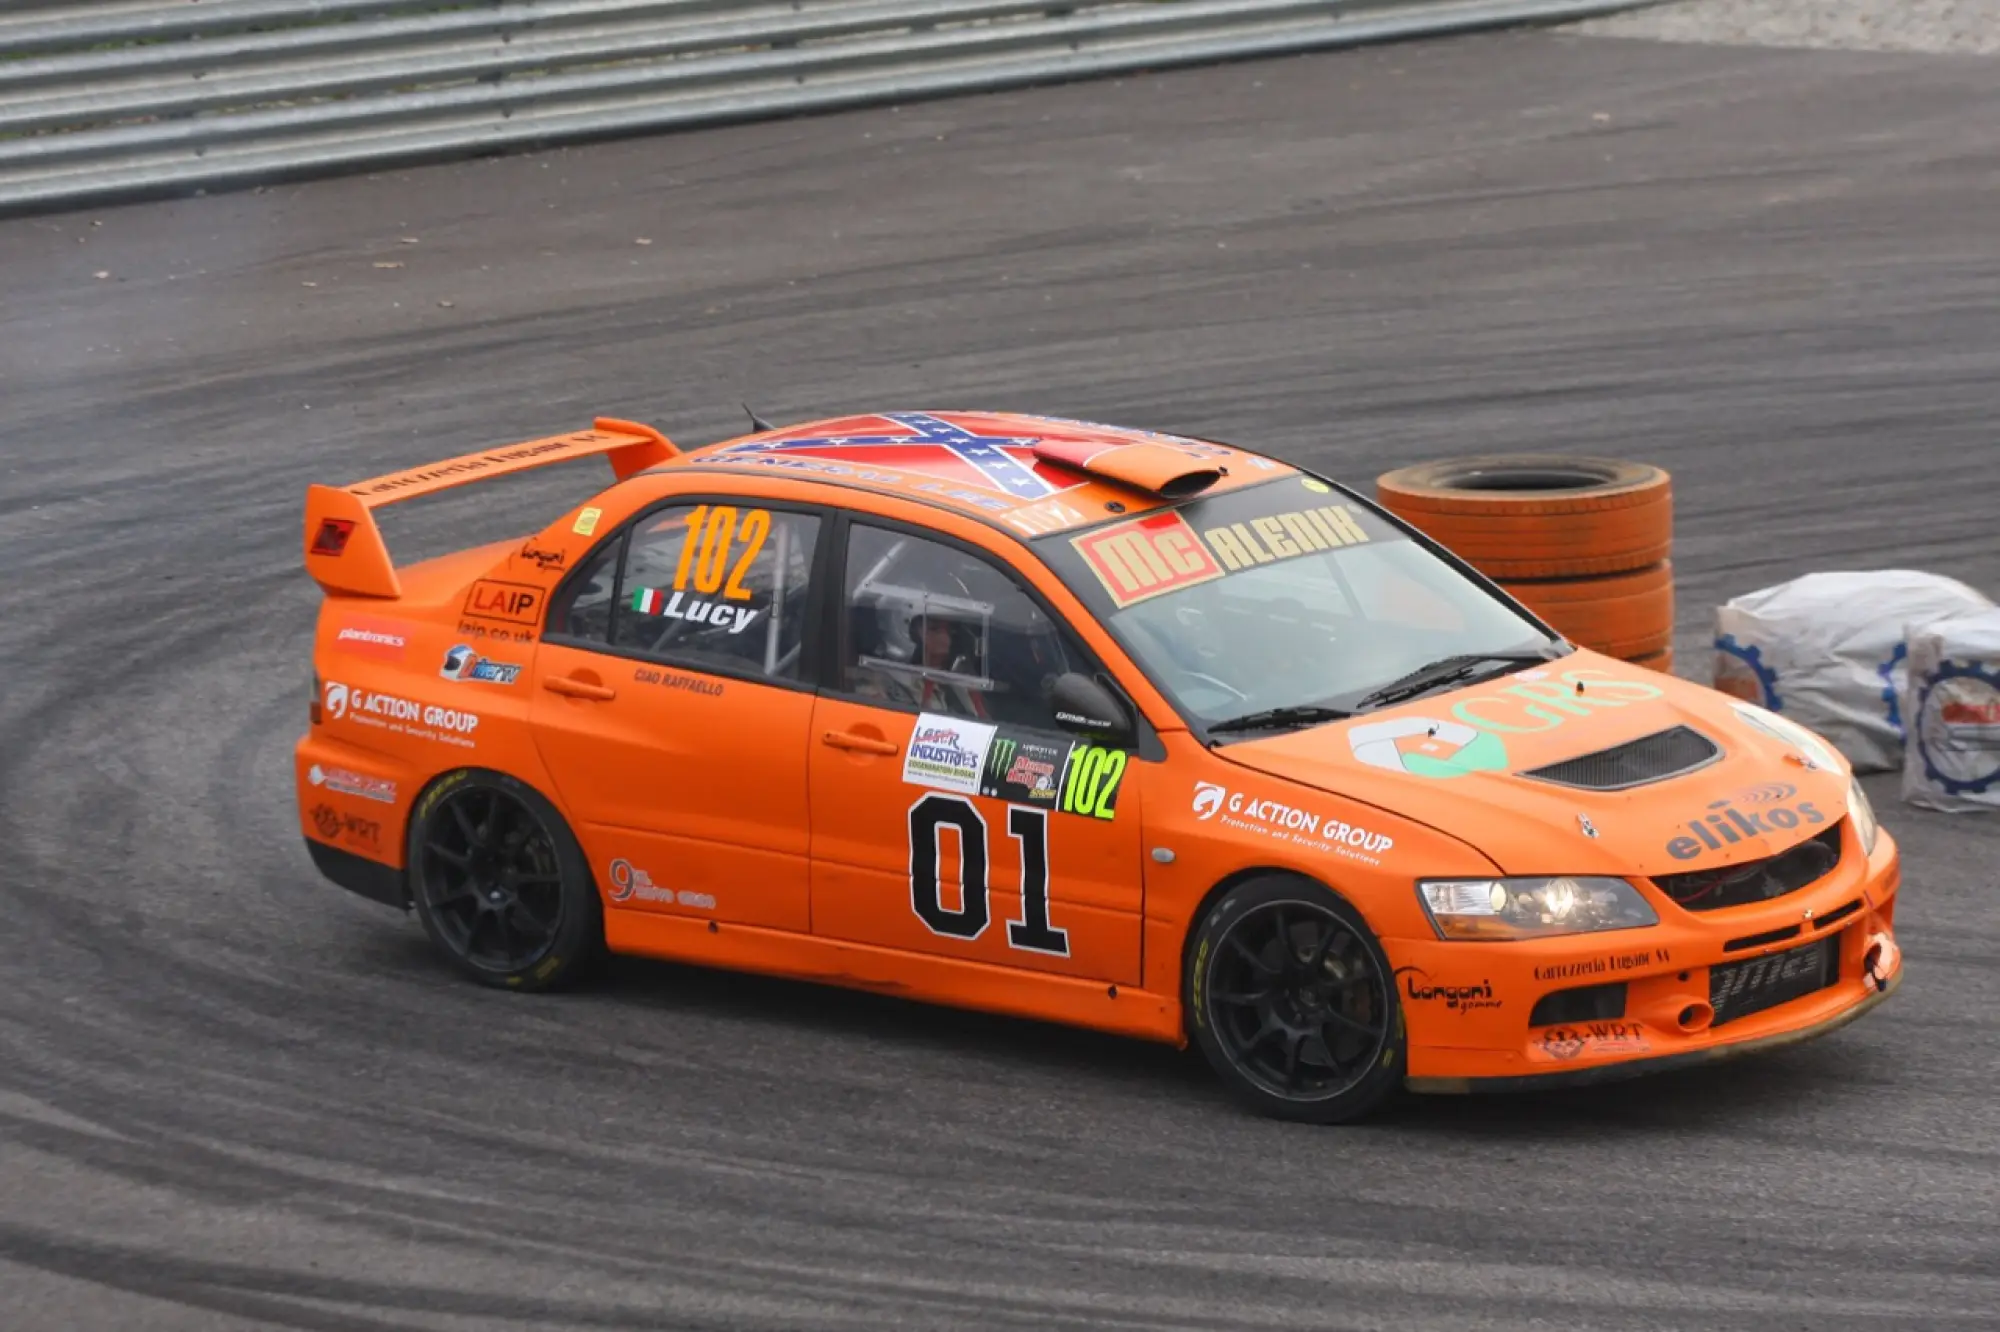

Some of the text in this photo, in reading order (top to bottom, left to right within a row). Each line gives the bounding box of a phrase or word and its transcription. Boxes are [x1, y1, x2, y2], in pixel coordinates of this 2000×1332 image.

[672, 503, 772, 600] 102
[473, 586, 535, 615] LAIP
[663, 591, 759, 634] Lucy
[351, 689, 478, 733] G ACTION GROUP
[1064, 744, 1128, 820] 102
[1220, 814, 1381, 866] Protection and Security Solutions
[1229, 792, 1393, 853] G ACTION GROUP
[907, 791, 1072, 959] 01
[1588, 1023, 1644, 1041] WRT
